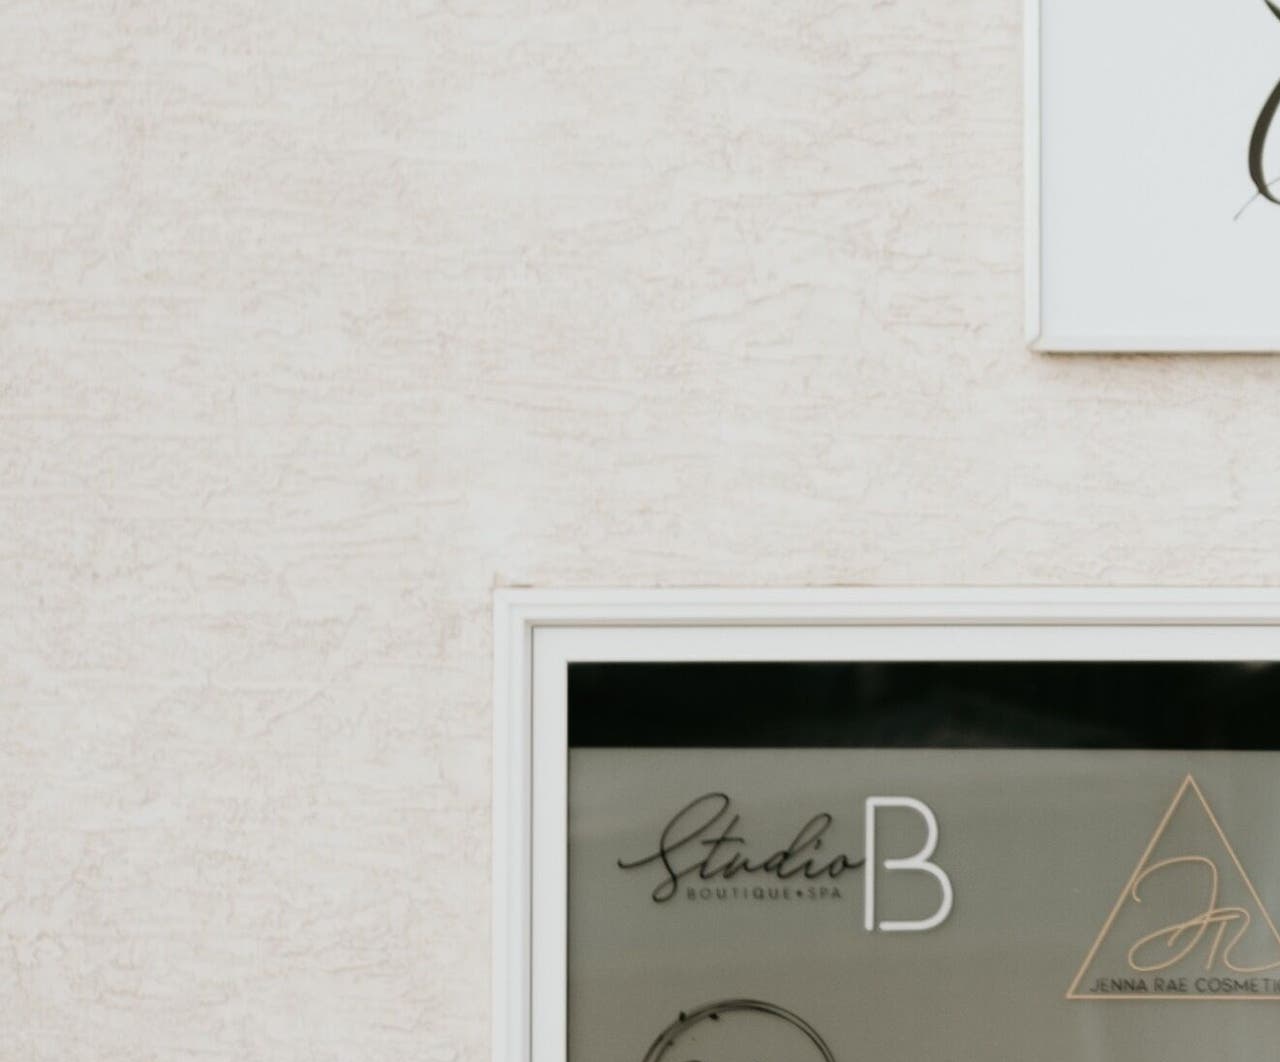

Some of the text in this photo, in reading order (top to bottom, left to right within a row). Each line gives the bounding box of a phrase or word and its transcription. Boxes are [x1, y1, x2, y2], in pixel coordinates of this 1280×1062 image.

[616, 792, 954, 932] Studio B
[1089, 977, 1148, 994] JENNA
[1153, 977, 1188, 994] RAE
